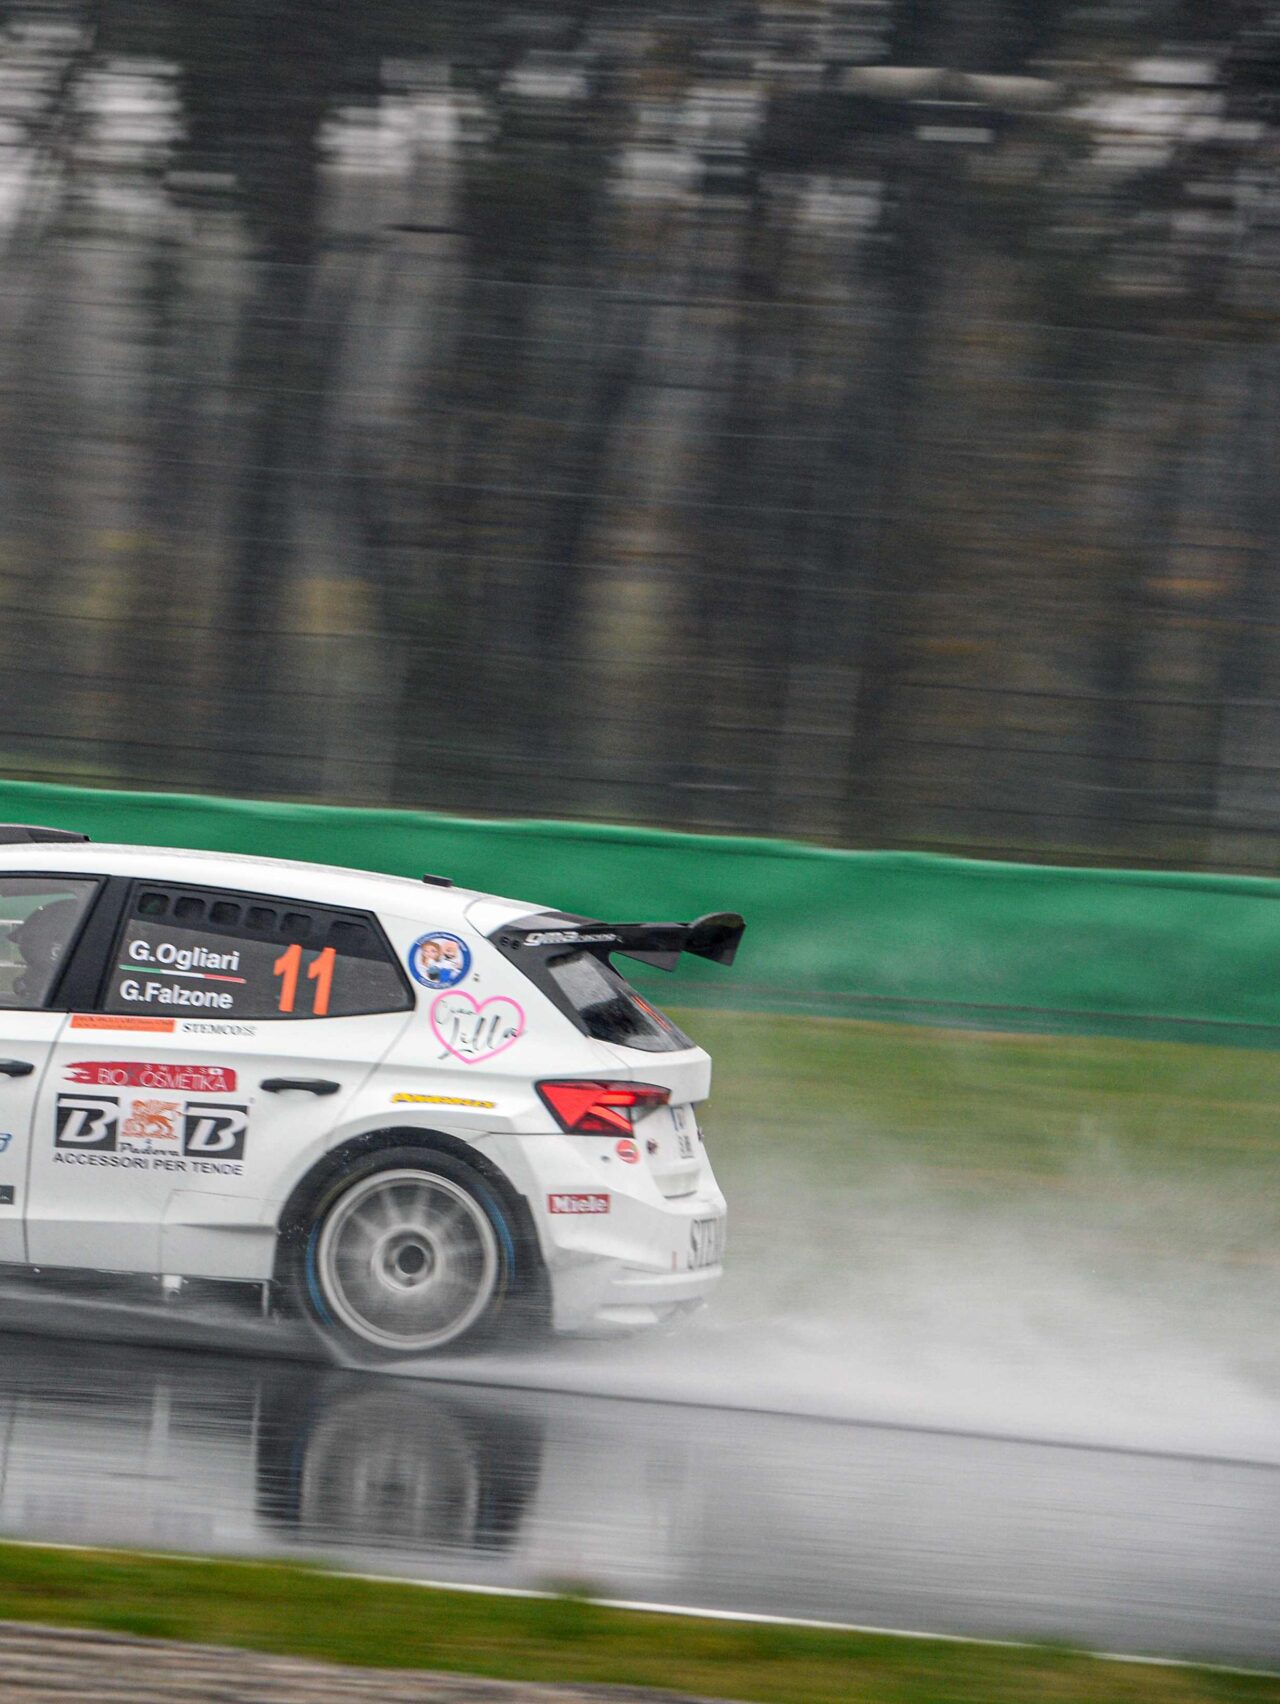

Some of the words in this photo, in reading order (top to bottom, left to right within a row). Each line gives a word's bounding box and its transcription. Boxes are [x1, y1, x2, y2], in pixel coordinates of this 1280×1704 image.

[128, 939, 240, 971] G.Ogliari
[119, 979, 234, 1009] G.Falzone
[273, 943, 336, 1016] 11
[58, 1097, 120, 1143] B
[186, 1106, 249, 1152] B
[52, 1152, 149, 1170] ACCESSORI
[153, 1158, 186, 1173] PER
[191, 1161, 244, 1176] TENDE
[551, 1195, 608, 1213] Miele
